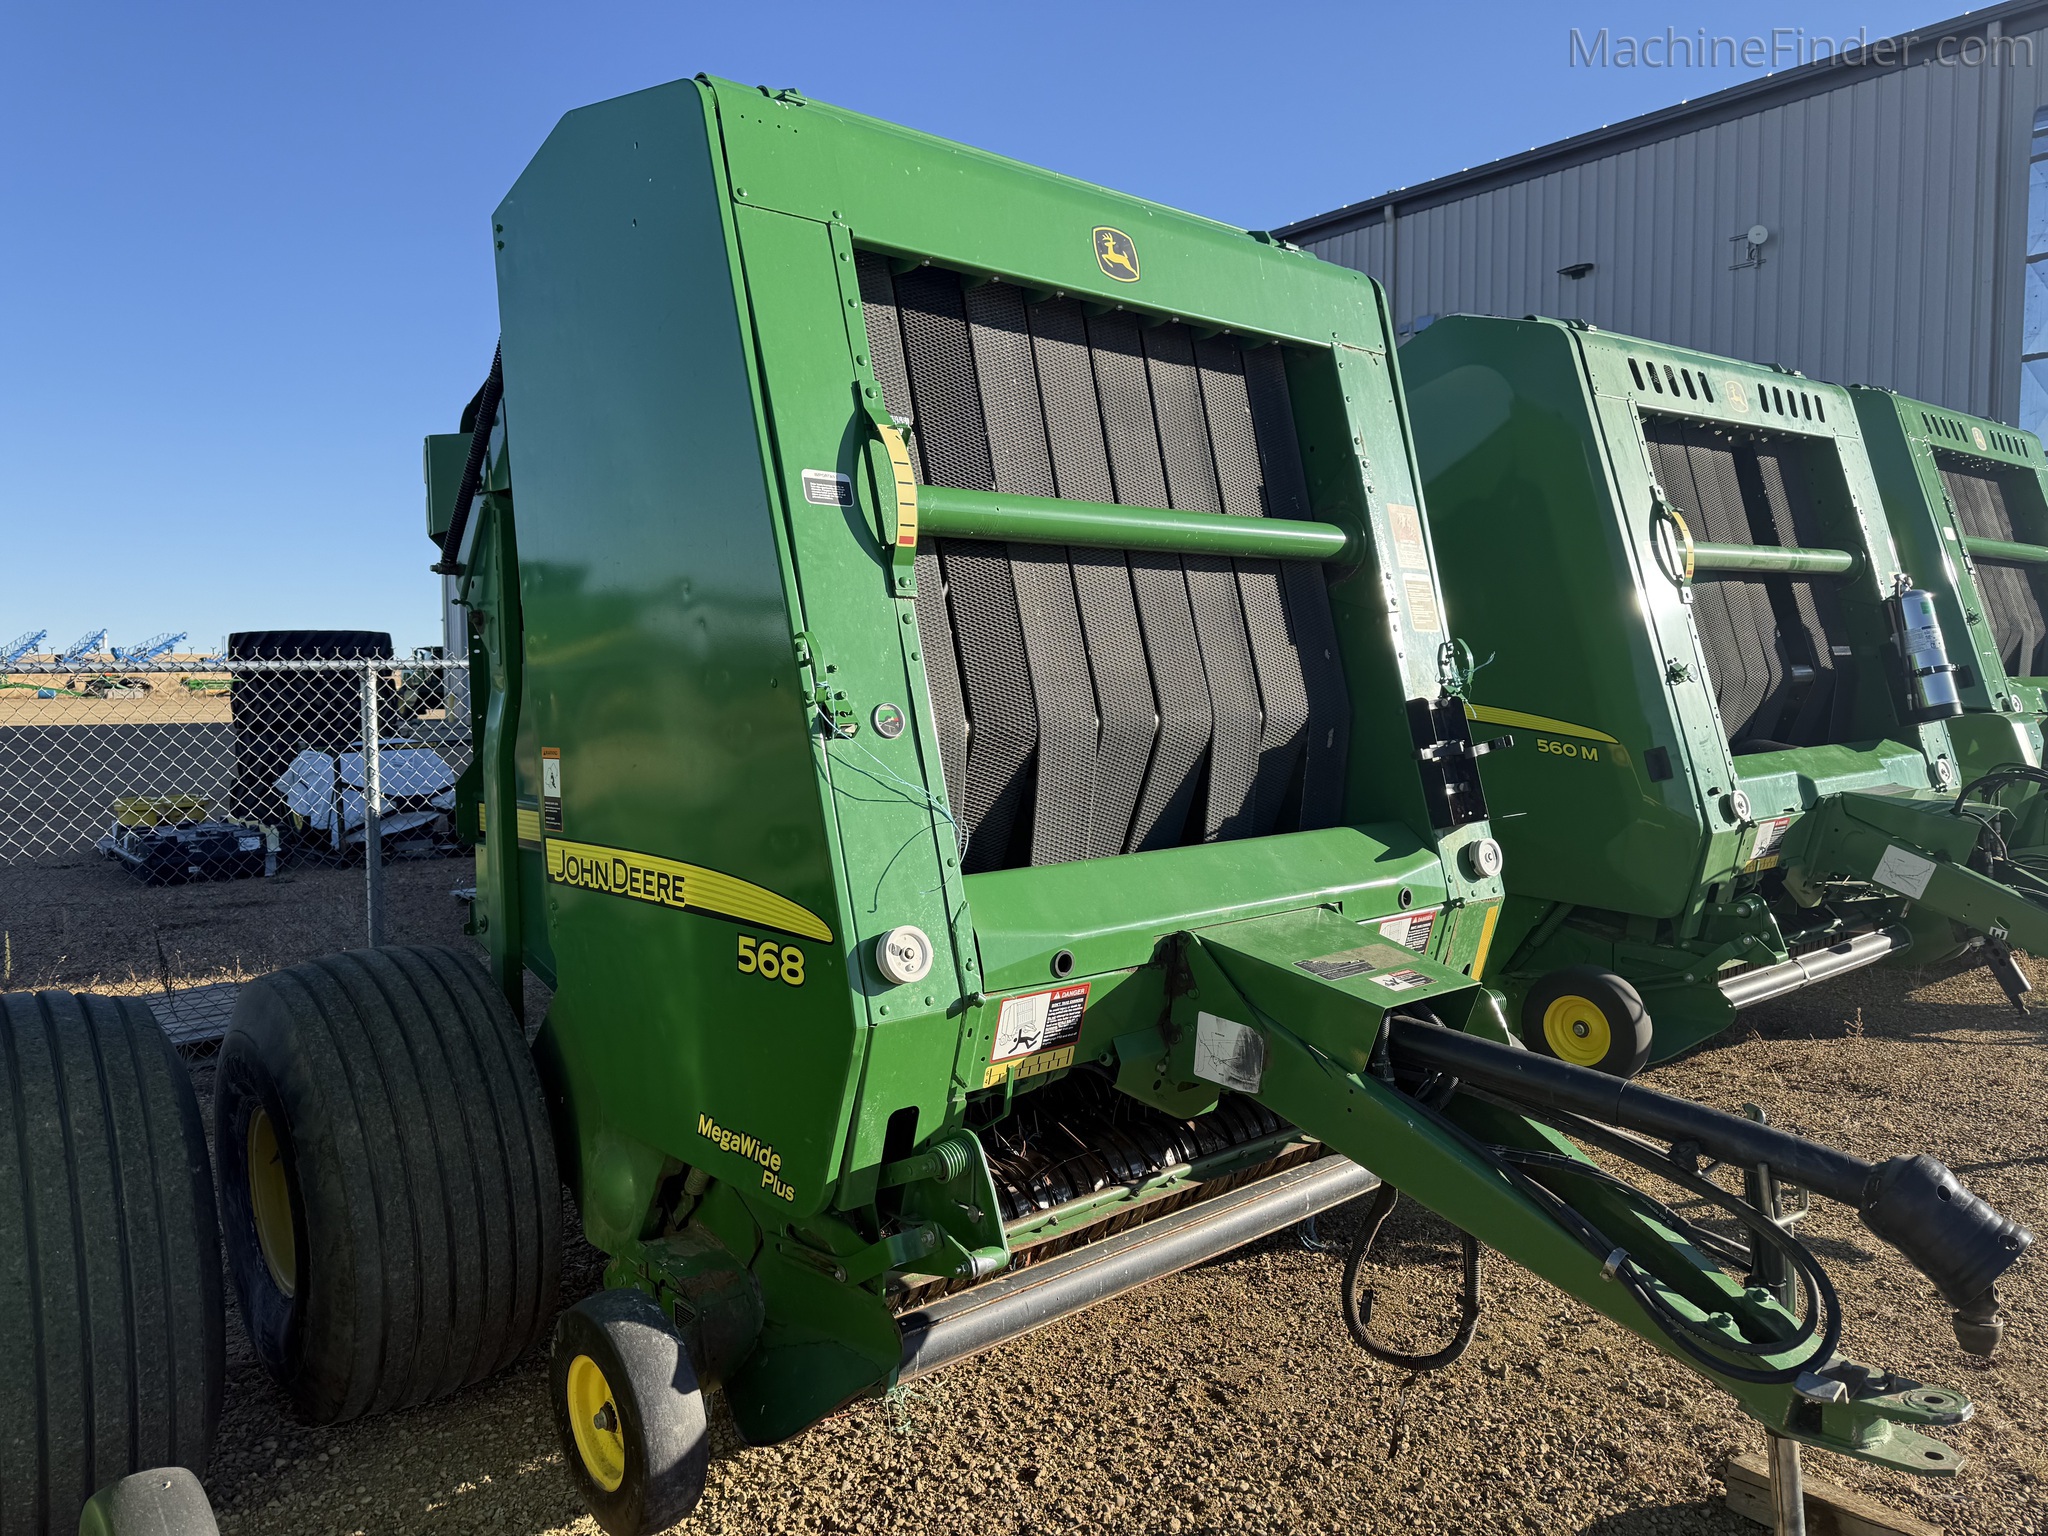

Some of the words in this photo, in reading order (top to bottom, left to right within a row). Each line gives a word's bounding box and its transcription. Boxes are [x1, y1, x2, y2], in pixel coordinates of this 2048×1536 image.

[1536, 738, 1577, 757] 560
[1581, 745, 1599, 762] M
[555, 849, 609, 889] JOHN
[611, 857, 686, 905] DEERE
[737, 934, 805, 986] 568
[1061, 988, 1085, 998] DANGER
[697, 1112, 782, 1172] MegaWide
[761, 1169, 796, 1202] Plus
